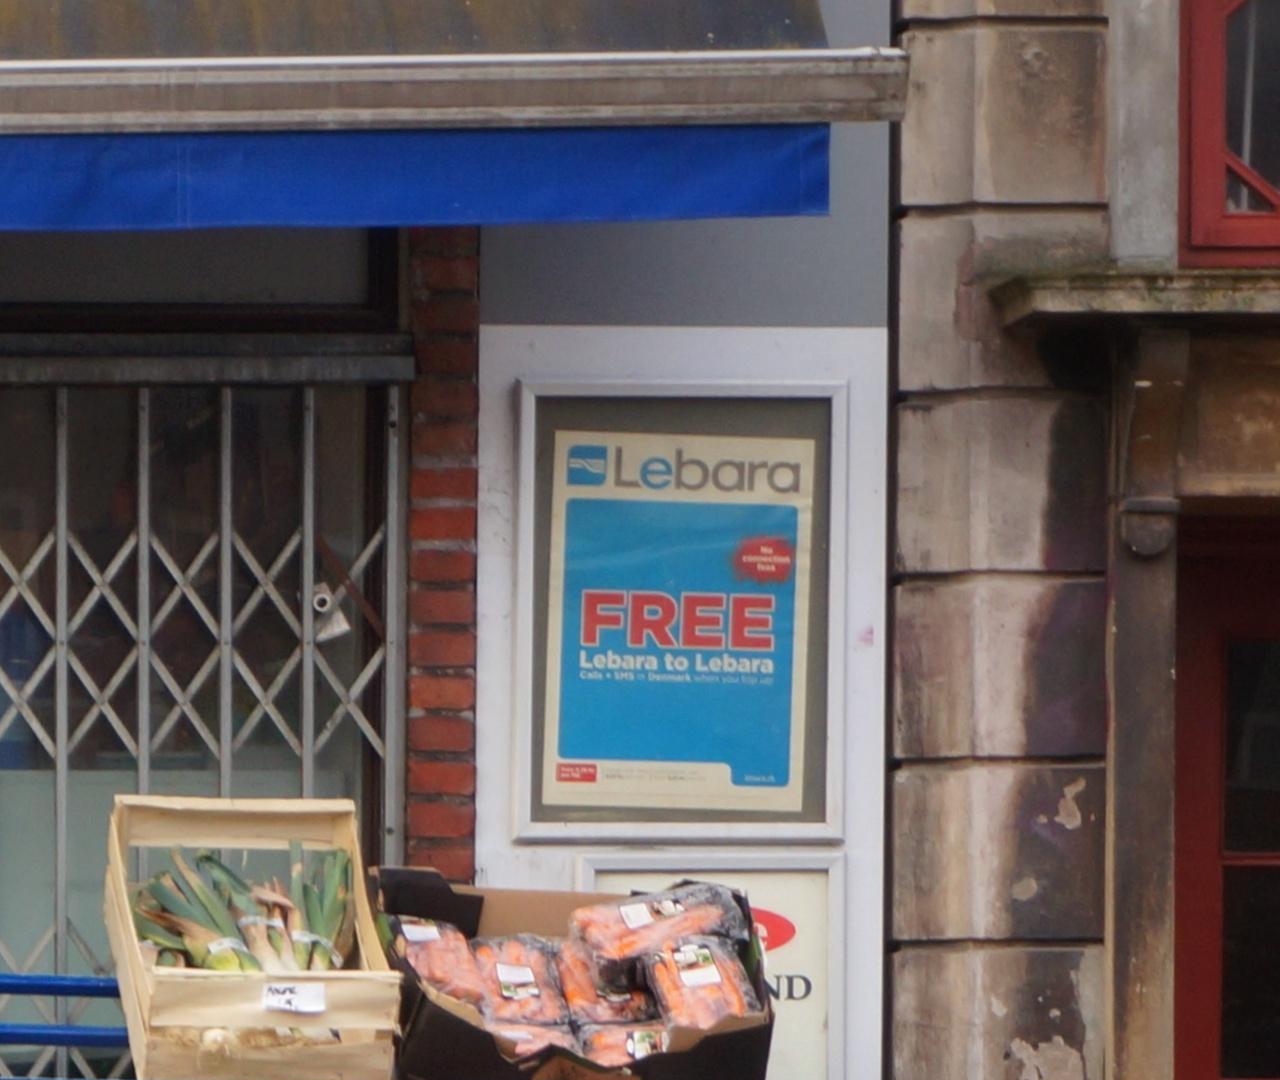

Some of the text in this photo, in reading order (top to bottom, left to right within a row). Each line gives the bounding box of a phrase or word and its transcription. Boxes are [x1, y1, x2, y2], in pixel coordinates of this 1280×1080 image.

[614, 445, 801, 494] Lebara
[580, 590, 775, 650] FREE
[579, 650, 774, 674] Lebara to Lebara
